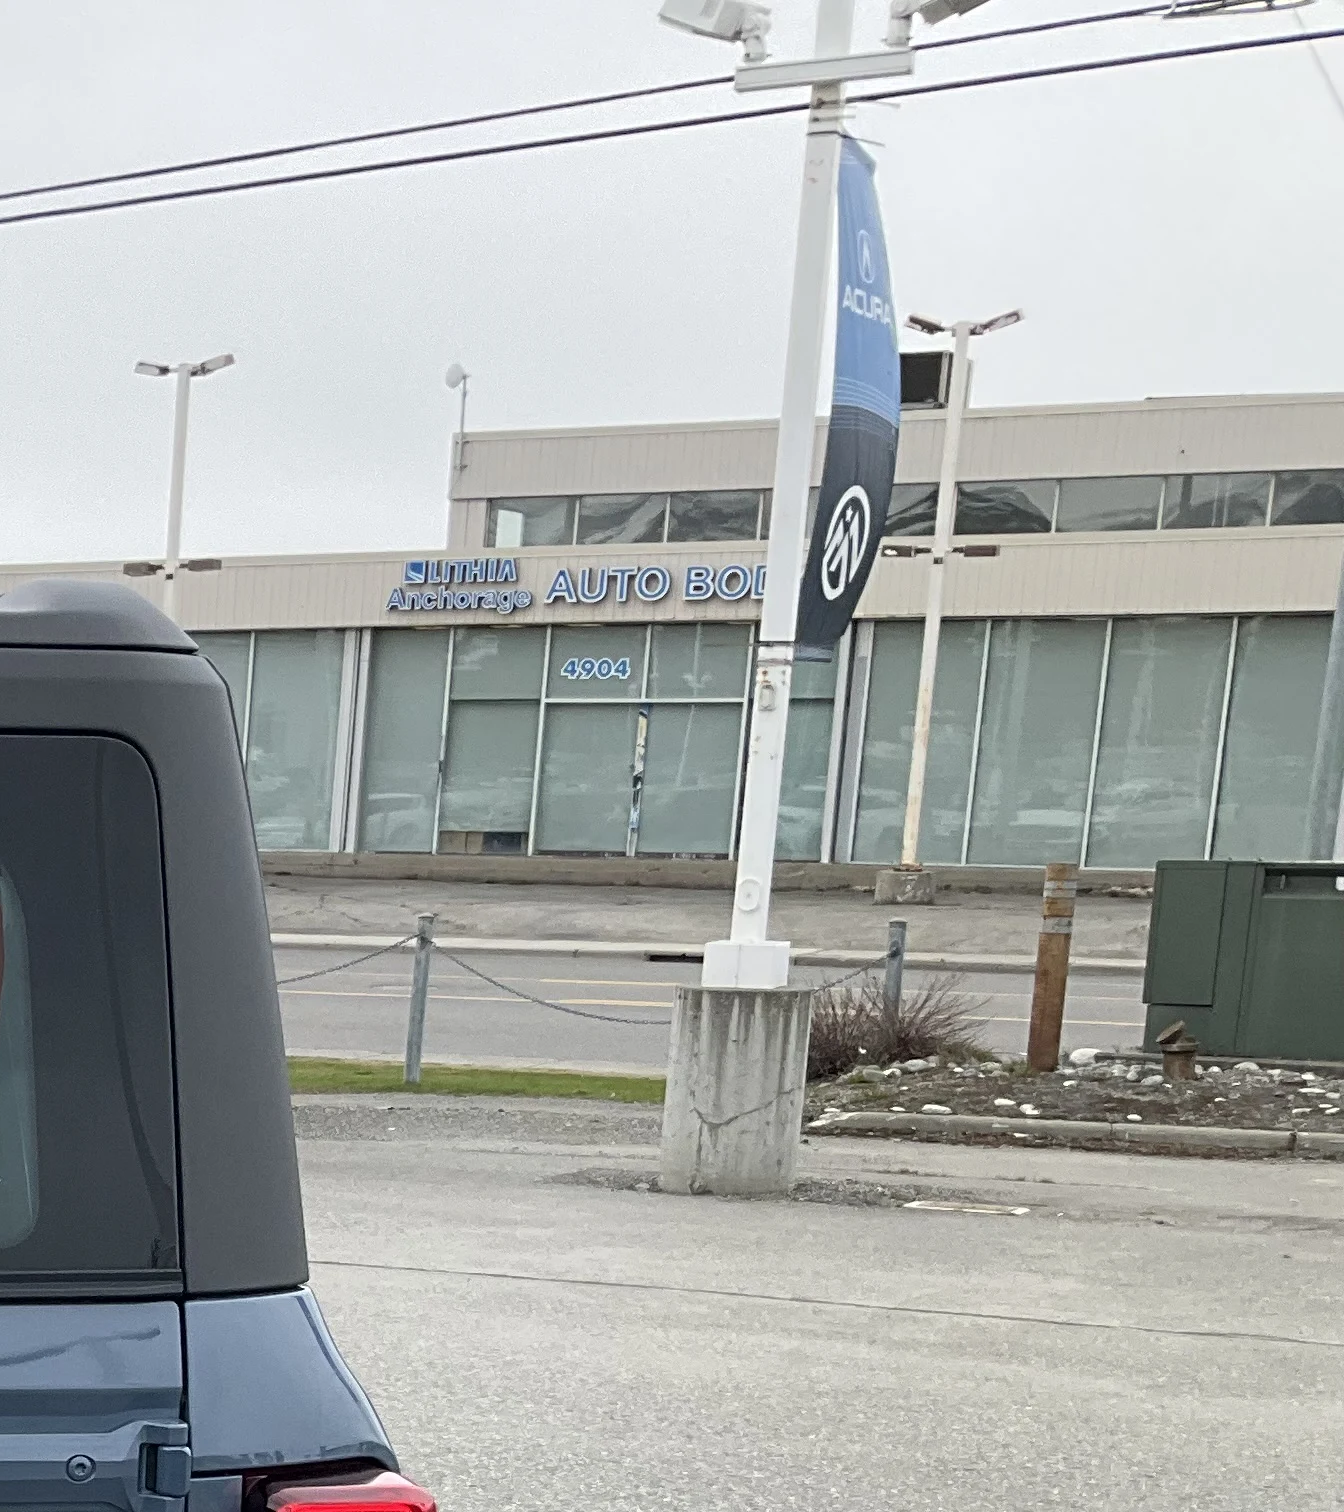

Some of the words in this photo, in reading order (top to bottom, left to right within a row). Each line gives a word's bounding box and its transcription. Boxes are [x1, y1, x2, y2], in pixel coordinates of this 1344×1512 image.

[842, 284, 893, 325] ACURA
[427, 558, 518, 584] LITHIA
[544, 563, 671, 604] AUTO
[385, 585, 533, 615] Anchorage
[560, 657, 631, 681] 4904
